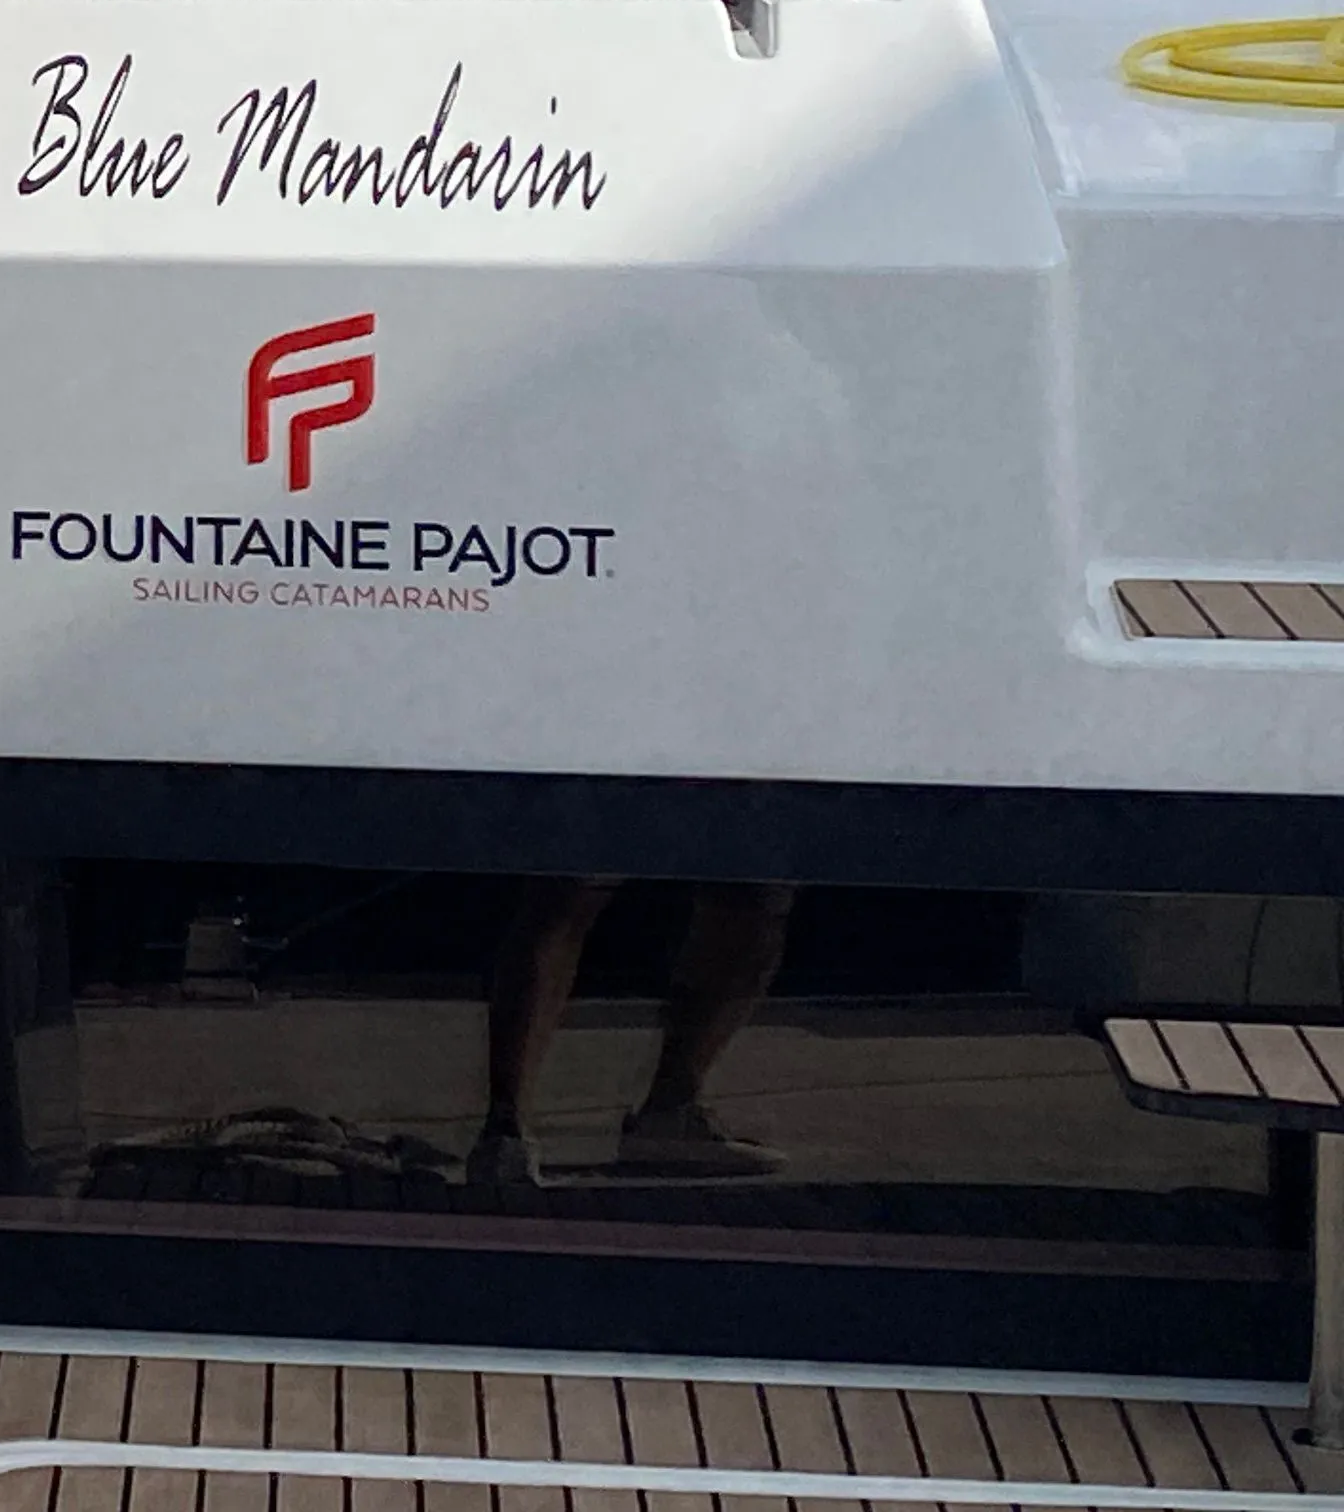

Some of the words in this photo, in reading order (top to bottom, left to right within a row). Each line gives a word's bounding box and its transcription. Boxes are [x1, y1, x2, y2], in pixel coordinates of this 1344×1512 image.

[17, 53, 190, 199] Blue
[216, 61, 607, 212] Mandarin
[12, 511, 391, 571] FOUNTAINE
[413, 522, 616, 587] PAJOT
[132, 577, 260, 605] SAILING
[269, 583, 491, 613] CATAMARANS
